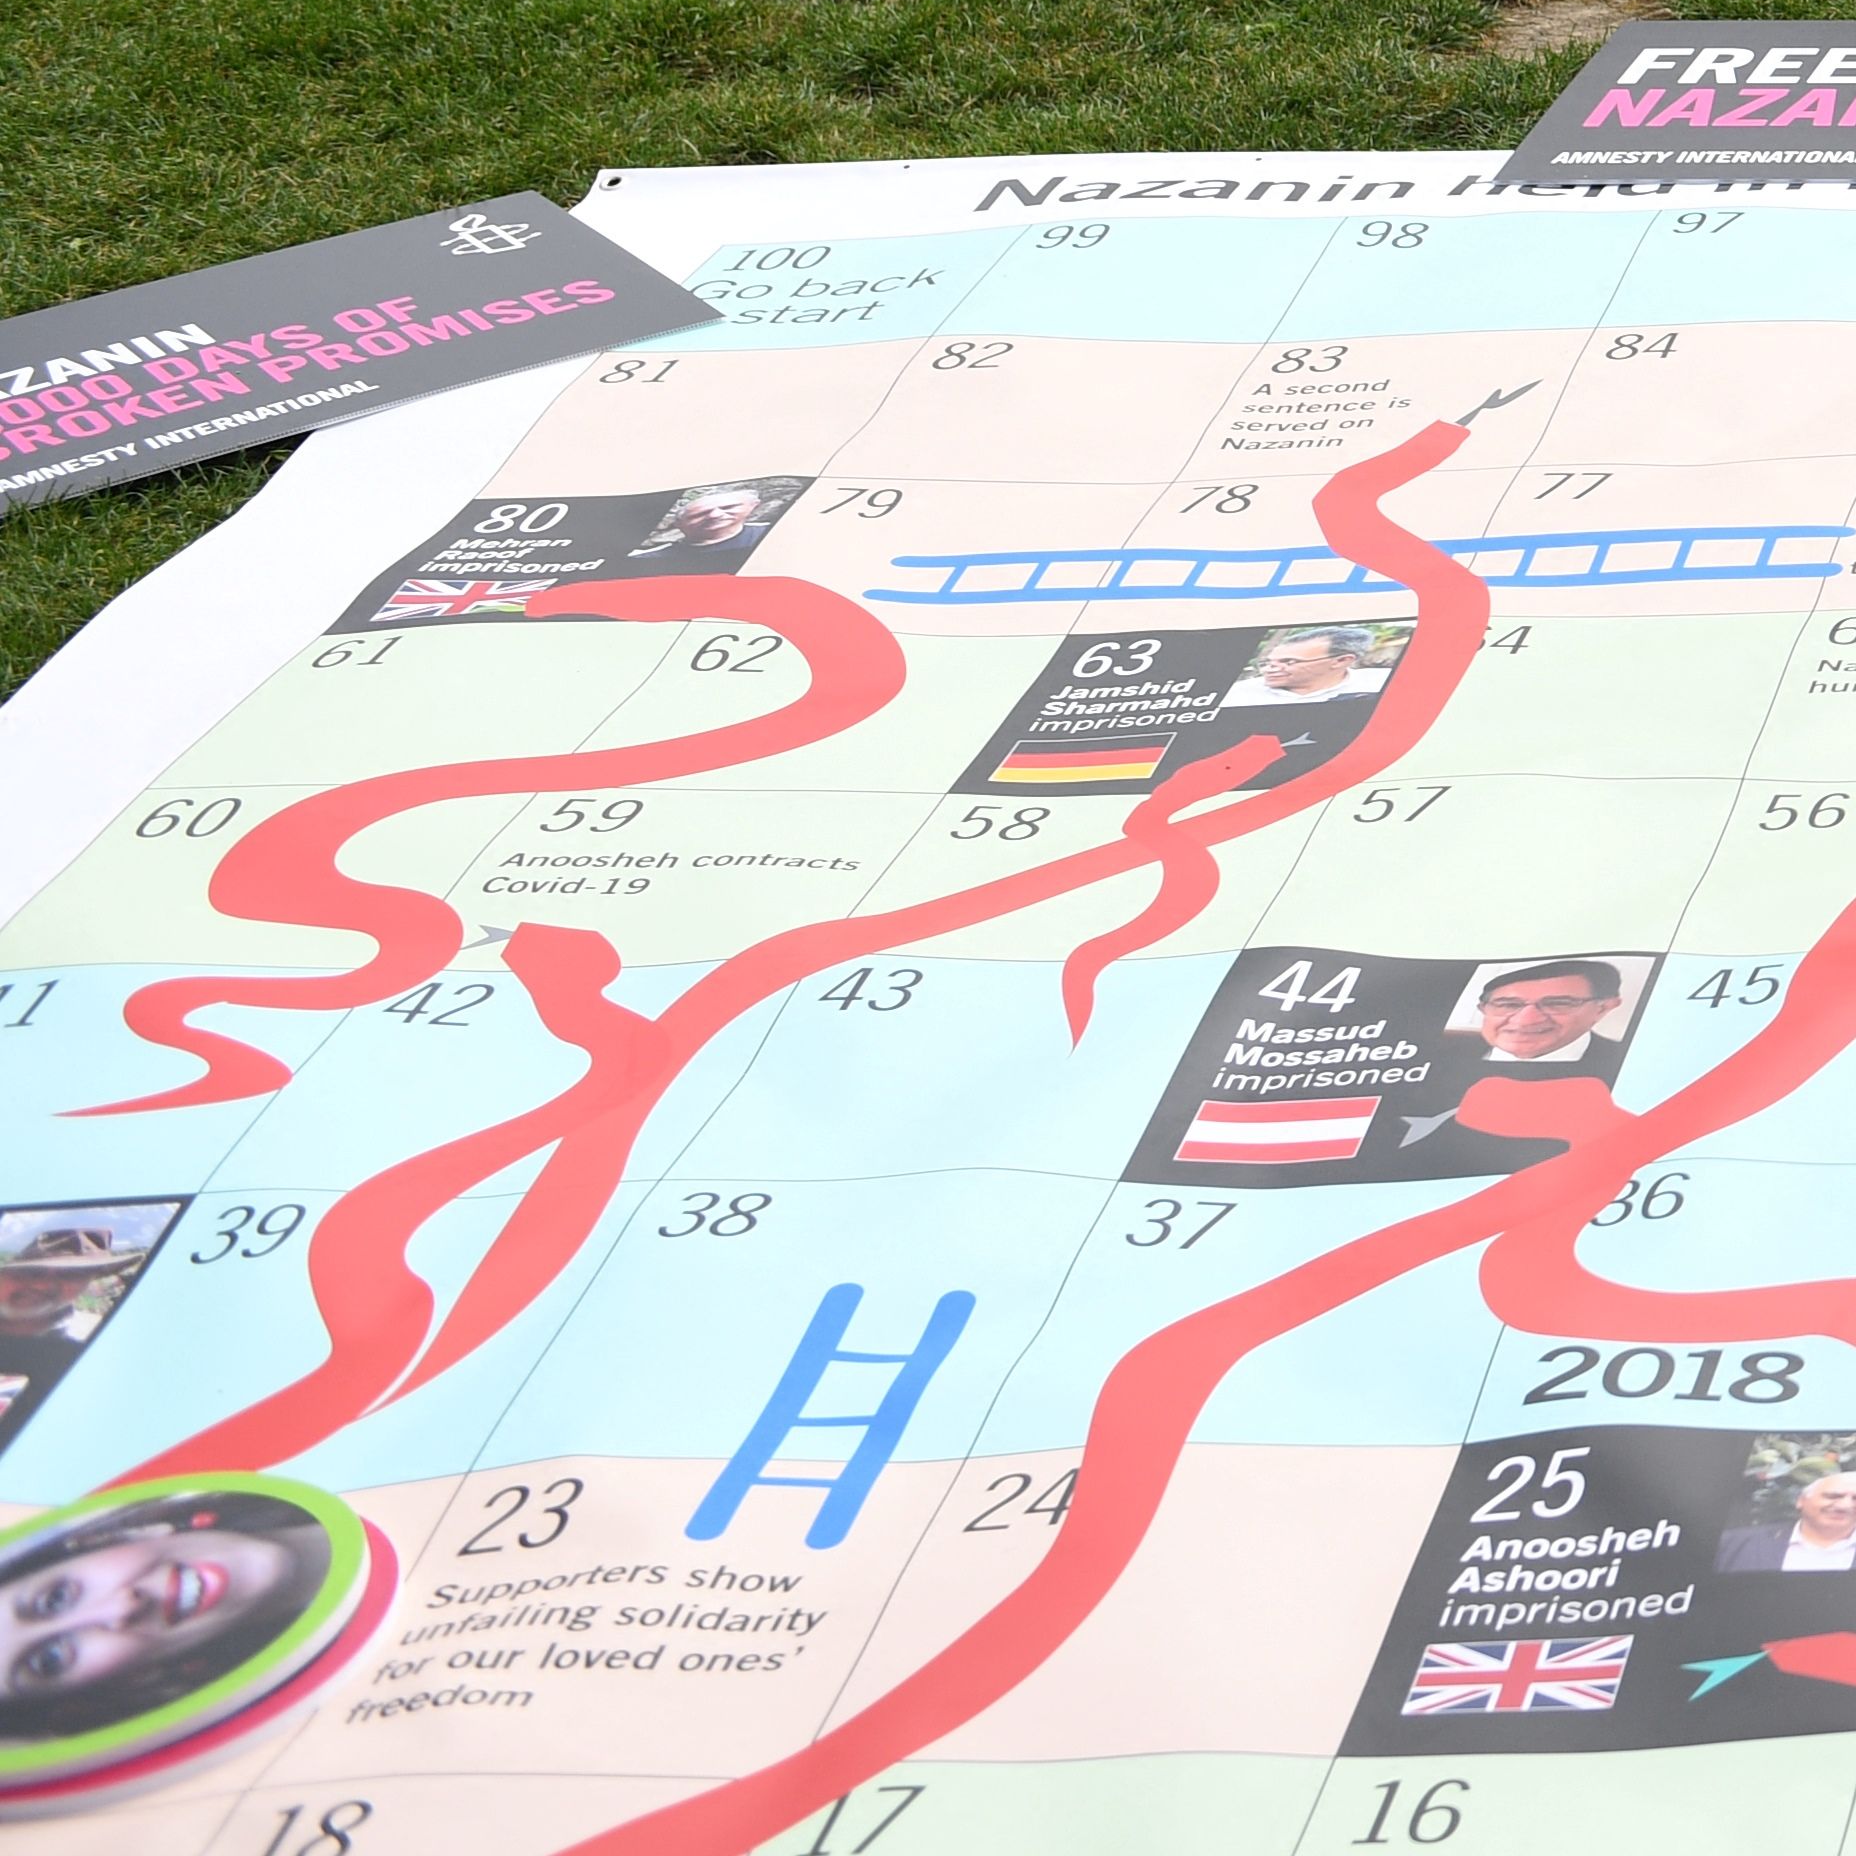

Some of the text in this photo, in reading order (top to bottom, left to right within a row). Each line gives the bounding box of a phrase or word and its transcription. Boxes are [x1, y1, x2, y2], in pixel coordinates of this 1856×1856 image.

[1550, 150, 1672, 165] AMNESTY
[973, 176, 1416, 211] Nazanin
[722, 246, 832, 272] 100
[692, 267, 946, 302] Go back
[729, 300, 884, 324] start
[143, 296, 418, 385] DAYS OF
[258, 279, 616, 383] PROMISES
[1270, 345, 1348, 373] 83
[1242, 395, 1412, 414] sentence is
[1252, 379, 1390, 395] A second
[0, 380, 381, 493] AMNESTY INTERNATIONAL
[1231, 417, 1374, 432] served on
[1220, 436, 1343, 451] Nazanin
[473, 503, 569, 533] 80
[434, 547, 530, 562] Raoof
[448, 537, 572, 550] Mehran
[417, 558, 605, 576] imprisoned
[1071, 639, 1164, 679] 63
[1039, 691, 1220, 718] Sharmahd
[1050, 679, 1197, 702] Jamshid
[1029, 707, 1222, 735] imprisoned
[134, 797, 243, 839] 60
[538, 798, 645, 834] 59
[497, 850, 862, 873] Anoosheh contracts
[480, 875, 652, 896] Covid-19
[1257, 959, 1363, 1013] 44
[1236, 1019, 1387, 1046] Massud
[1222, 1040, 1419, 1069] Mossaheb
[1211, 1062, 1430, 1097] imprisoned
[1522, 1346, 1805, 1405] 2018
[1468, 1446, 1591, 1524] 25
[457, 1478, 584, 1556] 23
[1459, 1520, 1682, 1562] Anoosheh
[425, 1560, 802, 1611] Supporters show
[1447, 1559, 1620, 1597] Ashoori
[399, 1601, 828, 1646] unfailing solidarity
[1439, 1585, 1695, 1632] imprisoned
[373, 1655, 435, 1685] for
[445, 1644, 525, 1671] our
[538, 1641, 665, 1673] loved
[346, 1683, 534, 1722] freedom
